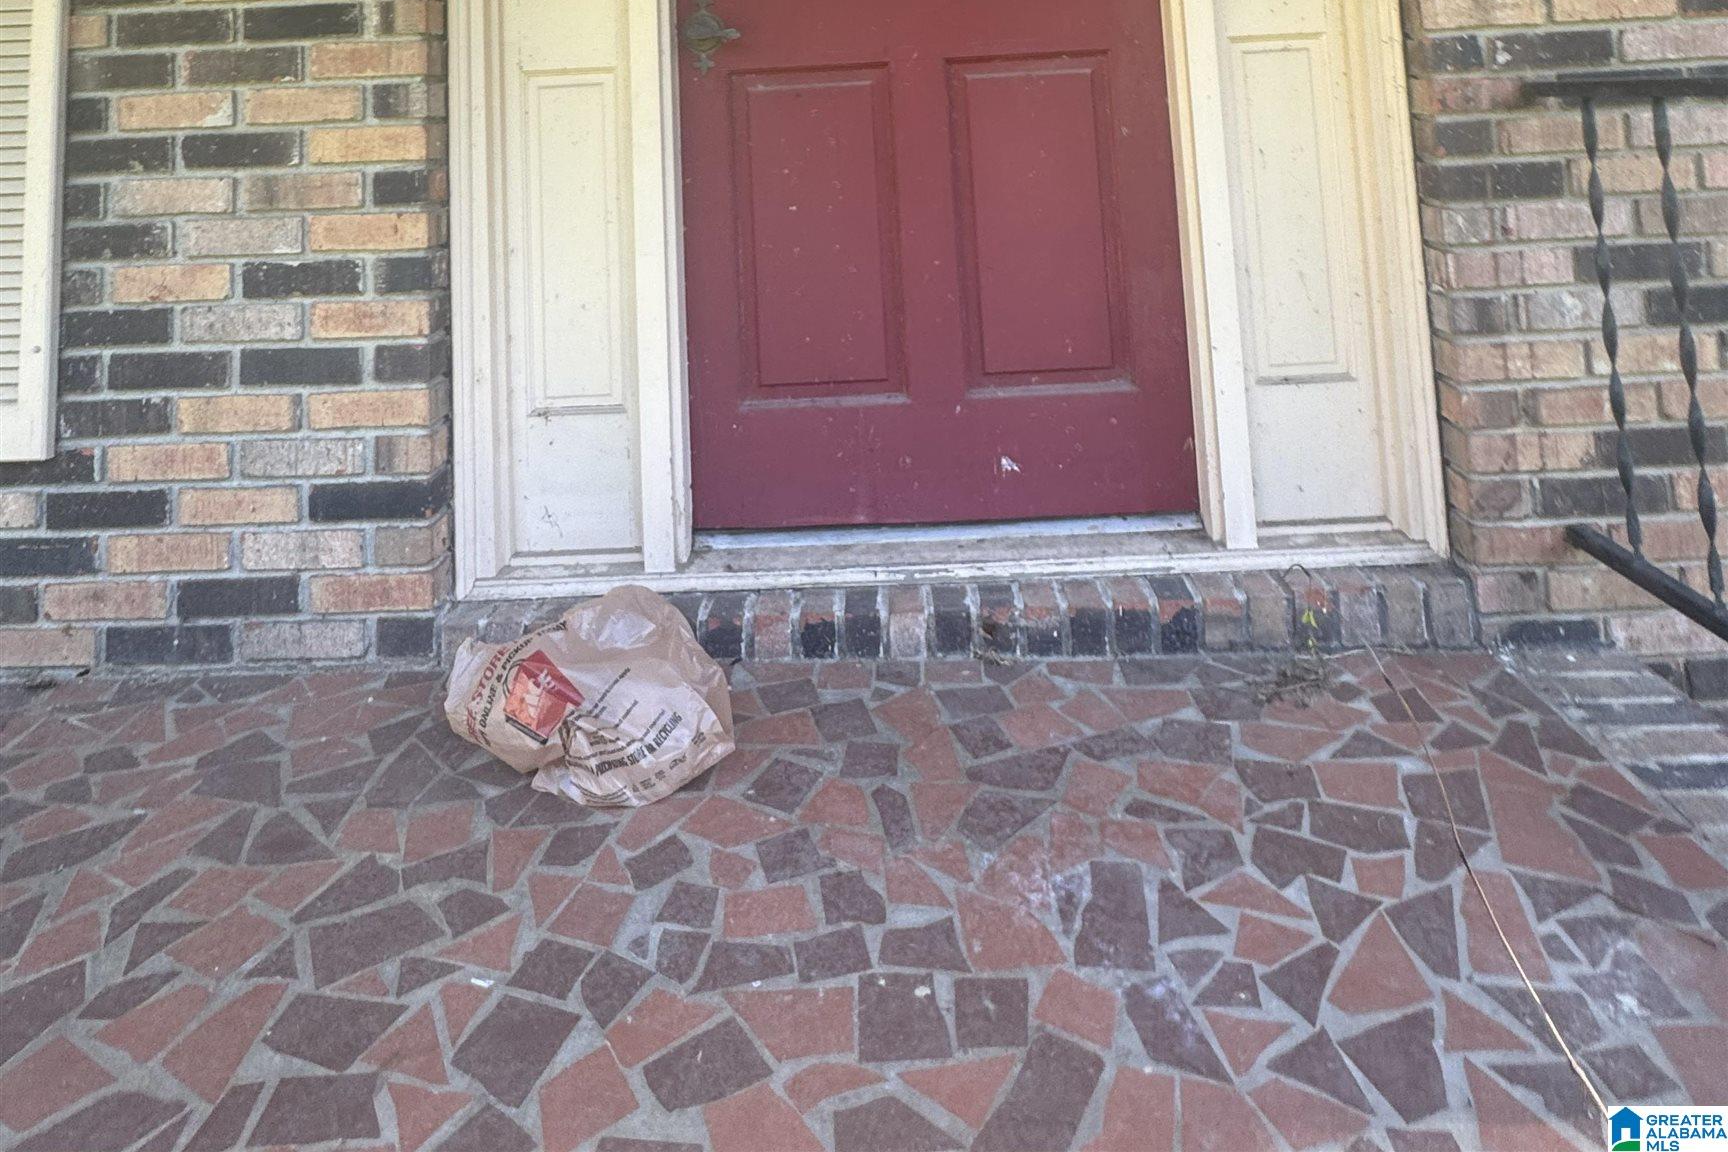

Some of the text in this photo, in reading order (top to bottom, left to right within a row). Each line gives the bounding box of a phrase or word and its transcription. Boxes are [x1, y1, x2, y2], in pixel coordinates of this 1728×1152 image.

[479, 684, 498, 728] ONLINE
[495, 673, 504, 684] &
[652, 711, 683, 748] RECYCLING
